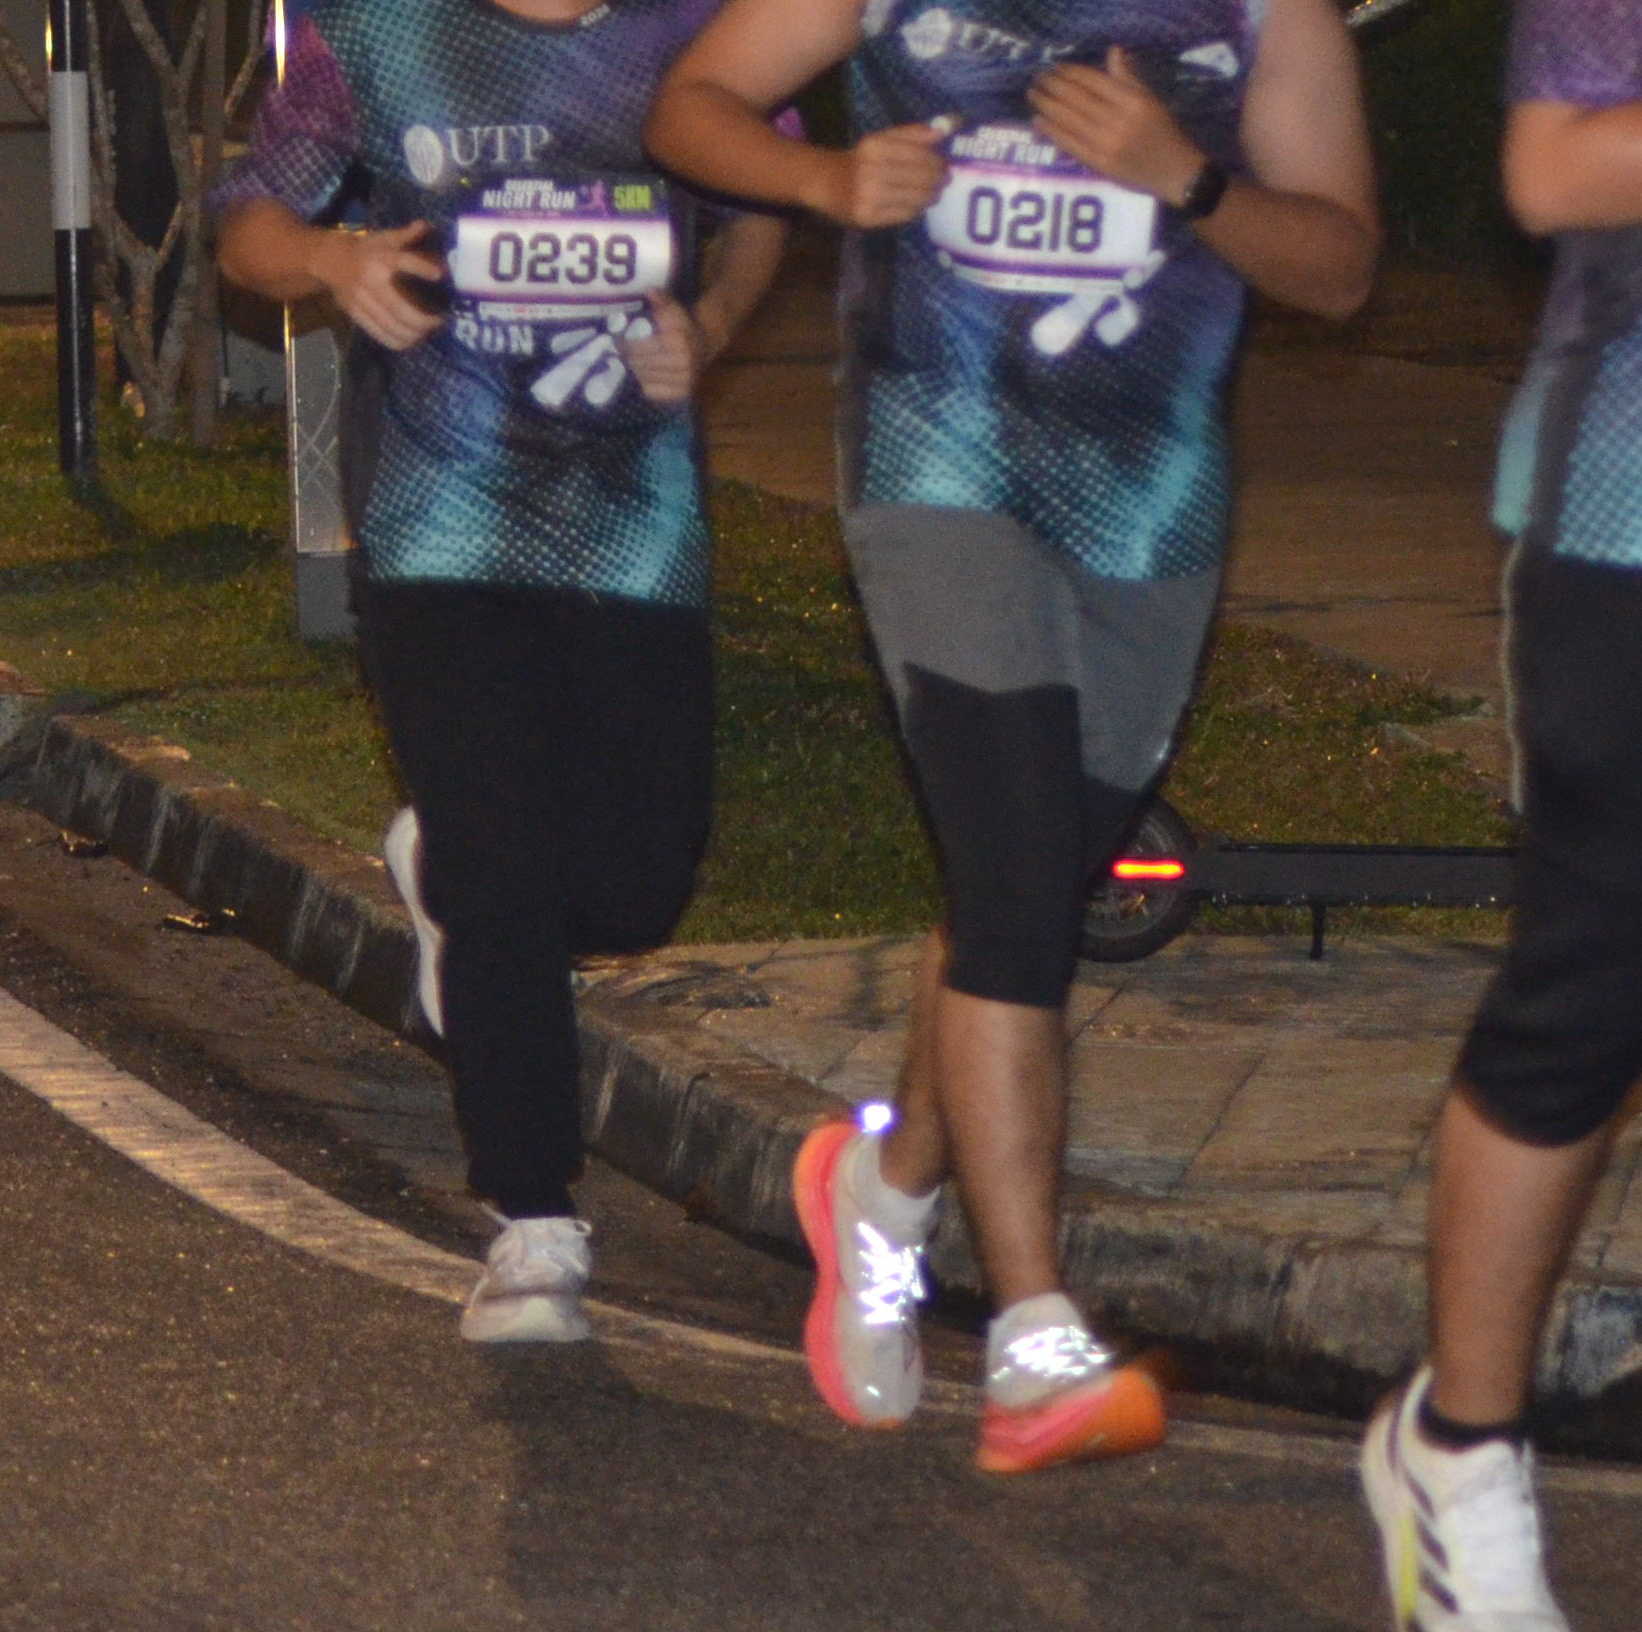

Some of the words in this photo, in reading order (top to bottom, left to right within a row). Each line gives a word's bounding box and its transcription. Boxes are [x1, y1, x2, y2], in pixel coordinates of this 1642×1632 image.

[445, 124, 551, 167] UTP
[1012, 143, 1056, 165] RUN
[482, 189, 536, 210] NIGHT
[539, 190, 577, 210] RUN
[965, 185, 1105, 254] 0218
[488, 230, 638, 285] 0239
[455, 317, 535, 356] RUN
